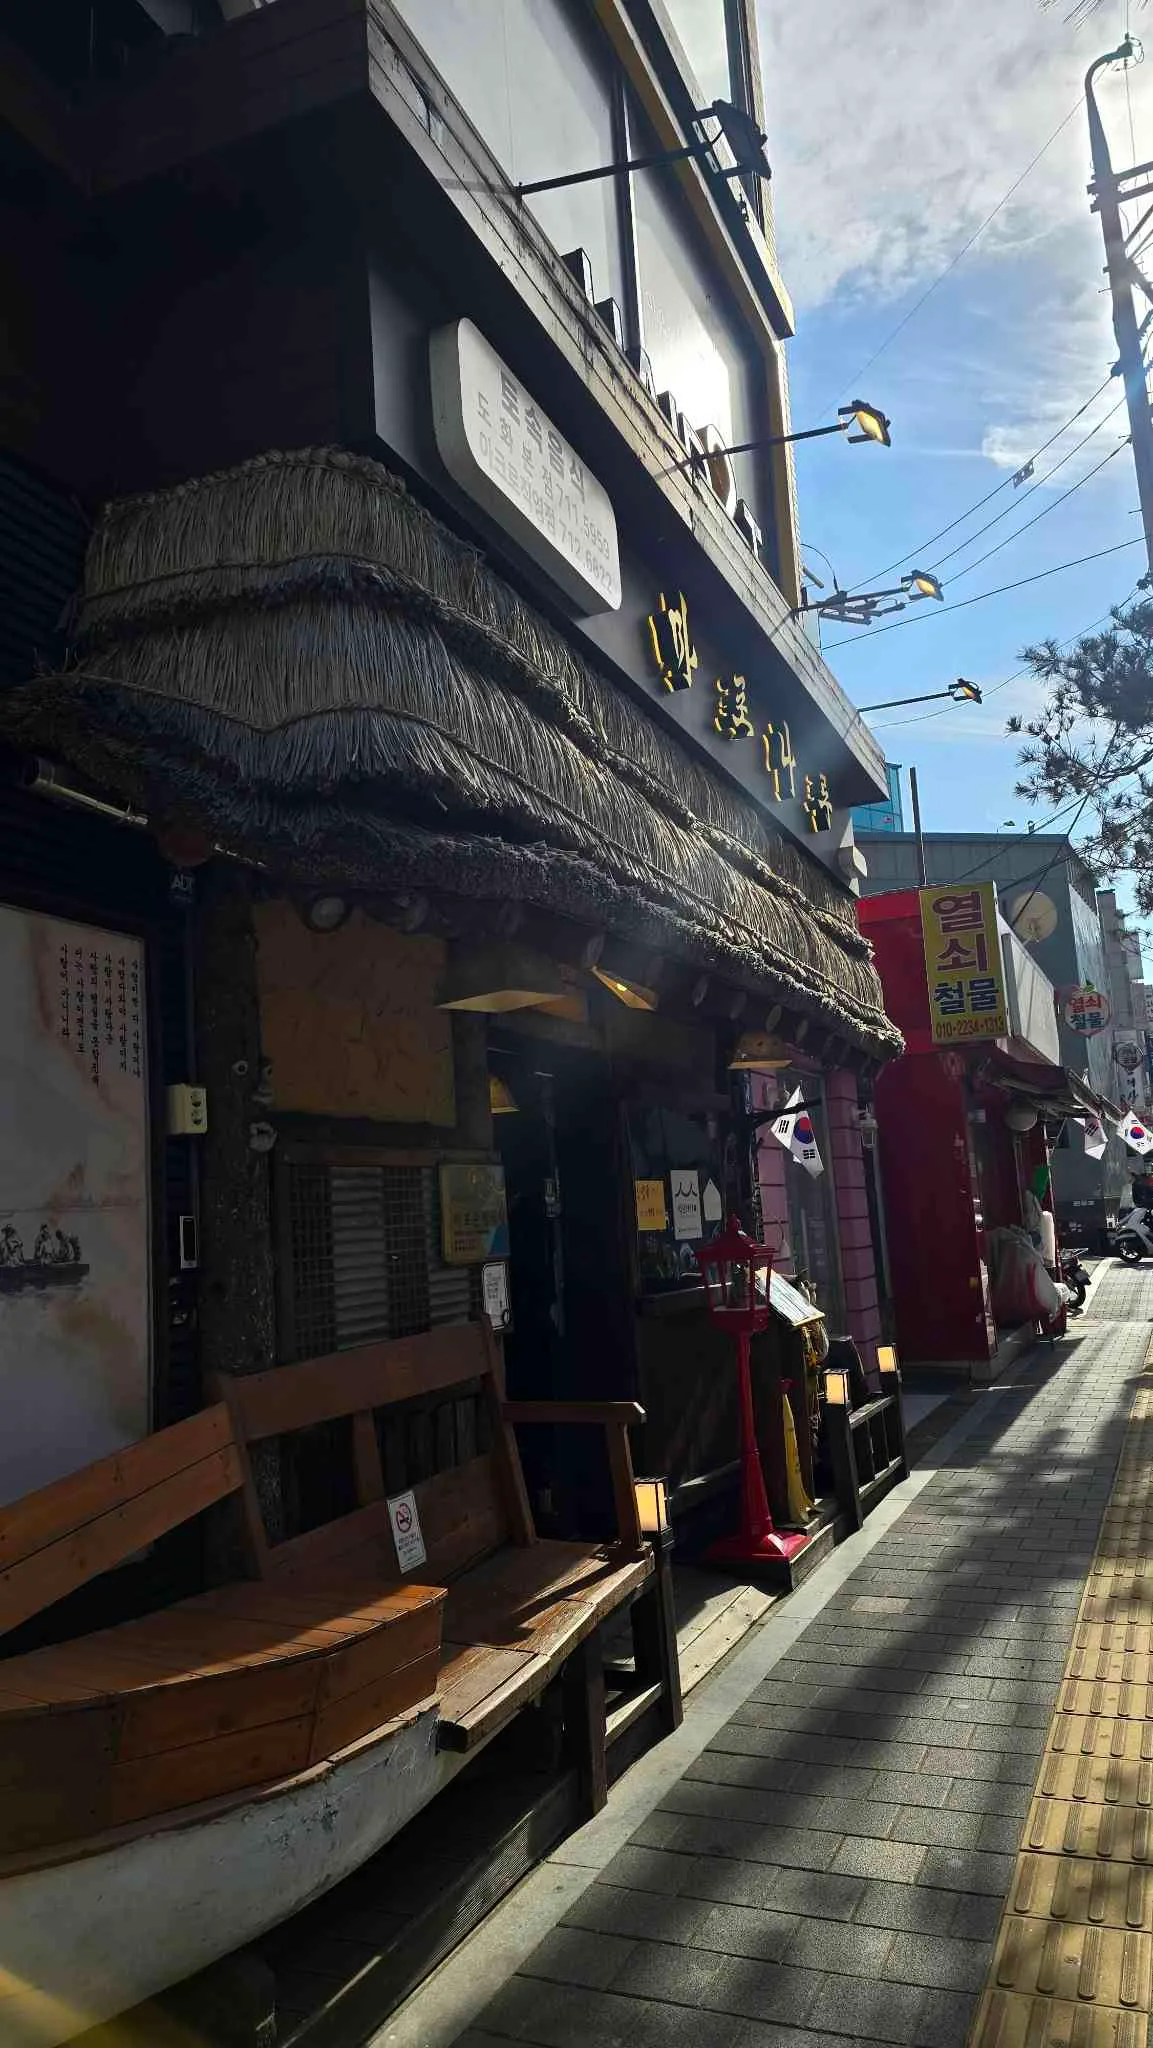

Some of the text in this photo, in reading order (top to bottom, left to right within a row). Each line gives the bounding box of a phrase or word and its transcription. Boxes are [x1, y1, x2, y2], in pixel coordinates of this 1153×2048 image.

[500, 370, 584, 504] 토속음식
[932, 891, 988, 974] 열쇠
[934, 978, 999, 1016] 철물
[1069, 995, 1101, 1014] 열쇠
[1071, 1012, 1105, 1029] 철물
